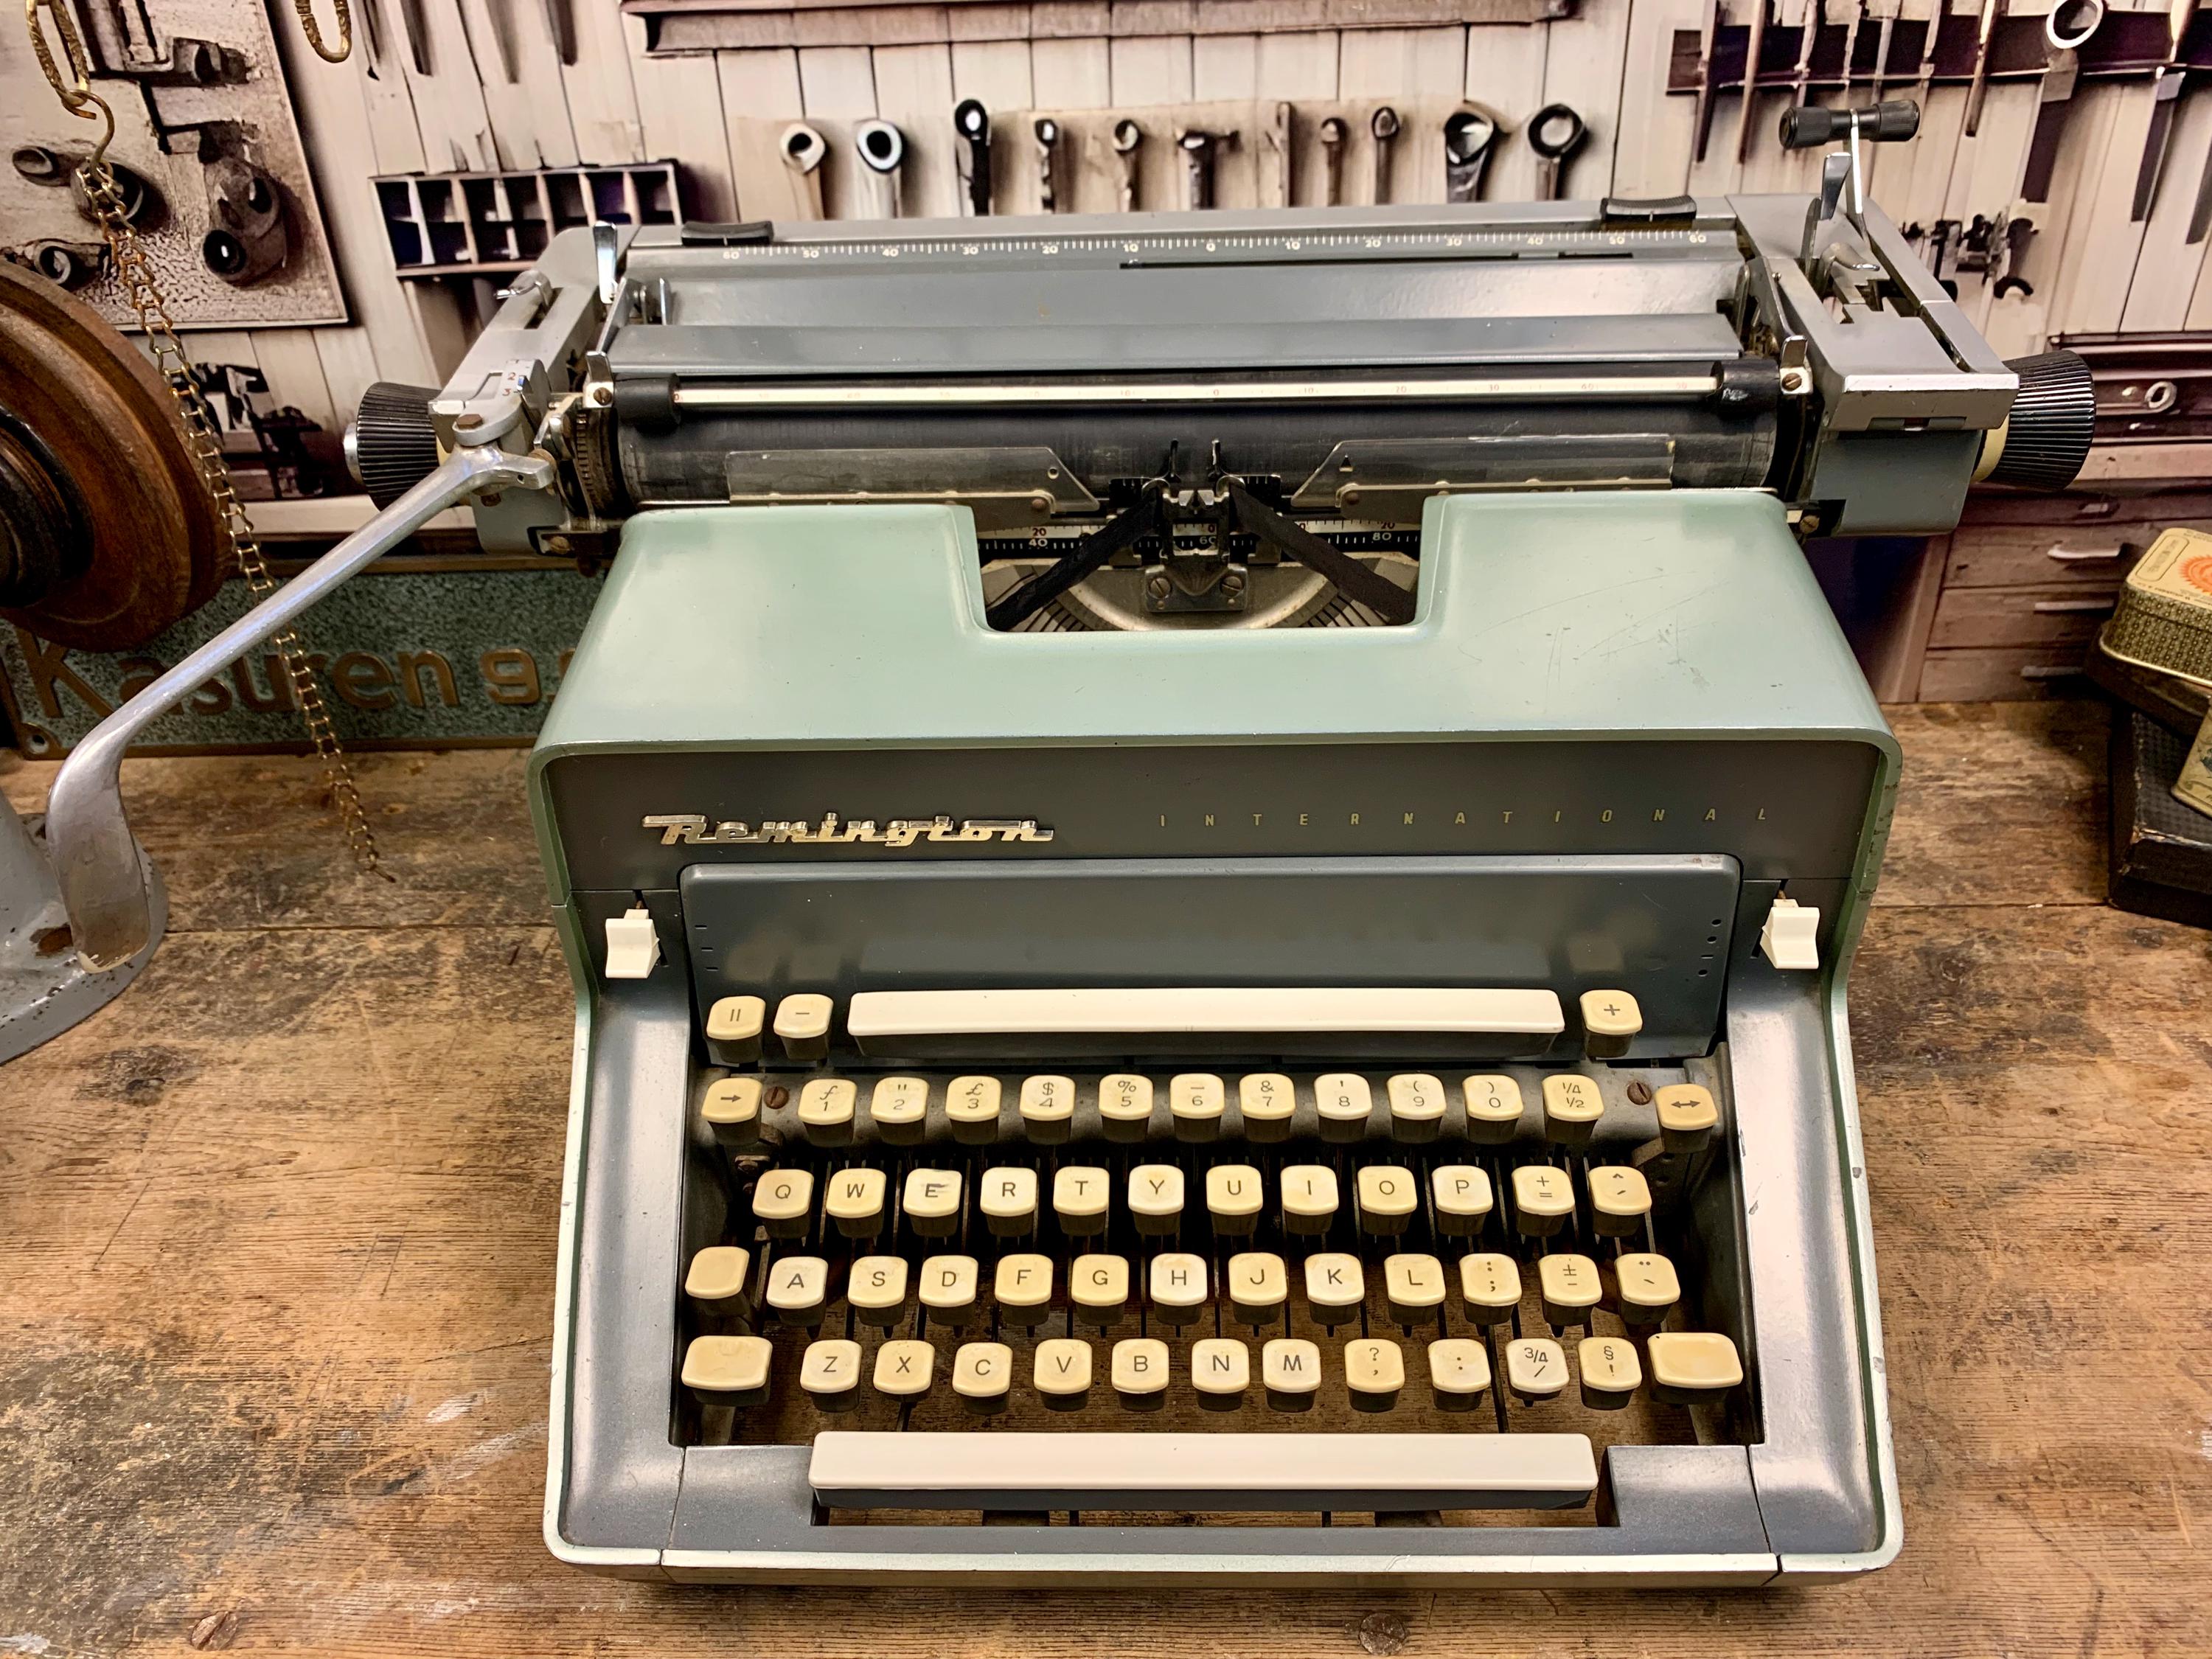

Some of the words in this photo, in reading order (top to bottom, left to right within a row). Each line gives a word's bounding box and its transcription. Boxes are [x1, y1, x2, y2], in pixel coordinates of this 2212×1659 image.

[802, 249, 820, 259] 50
[882, 248, 900, 257] 40
[961, 246, 979, 255] 30
[1042, 245, 1059, 254] 20
[1122, 243, 1139, 253] 10
[1206, 243, 1216, 252] 0
[1284, 240, 1301, 251] 10
[1364, 238, 1382, 248] 20
[1446, 237, 1463, 247] 30
[1526, 235, 1544, 246] 40
[1609, 235, 1626, 246] 50
[1688, 234, 1707, 244] 60
[507, 372, 516, 380] 2
[501, 388, 512, 397] 3
[1032, 527, 1047, 537] 20
[1208, 524, 1216, 534] 0
[1028, 538, 1048, 547] 40
[1371, 532, 1393, 541] 80
[641, 813, 1054, 847] Remington
[965, 1082, 984, 1096] £
[1042, 1082, 1054, 1096] $
[1117, 1080, 1137, 1093] %
[1260, 1080, 1275, 1093] &
[893, 1099, 905, 1110] 2
[967, 1098, 979, 1110] 3
[1039, 1098, 1053, 1108] 4
[1120, 1096, 1132, 1107] 5
[1192, 1096, 1203, 1106] 6
[1262, 1096, 1273, 1107] 7
[1338, 1096, 1351, 1107] 8
[1413, 1096, 1425, 1107] 9
[1489, 1097, 1501, 1108] 0
[774, 1184, 791, 1200] Q
[846, 1183, 865, 1198] W
[925, 1183, 939, 1198] E
[1001, 1182, 1016, 1197] R
[1074, 1180, 1089, 1196] T
[1149, 1179, 1165, 1195] Y
[1227, 1180, 1242, 1196] U
[1379, 1180, 1395, 1195] O
[1455, 1179, 1470, 1194] P
[787, 1273, 804, 1289] A
[872, 1270, 886, 1287] S
[942, 1270, 957, 1287] D
[1017, 1269, 1032, 1285] F
[1092, 1270, 1108, 1286] G
[1171, 1270, 1187, 1286] H
[1250, 1268, 1265, 1285] J
[1327, 1268, 1343, 1284] K
[1407, 1269, 1424, 1286] L
[1369, 1347, 1380, 1362] ?
[822, 1356, 838, 1373] Z
[896, 1356, 911, 1374] X
[975, 1359, 991, 1376] C
[1056, 1356, 1072, 1374] V
[1133, 1355, 1149, 1372] B
[1212, 1354, 1230, 1372] N
[1283, 1354, 1302, 1371] M
[1534, 1365, 1546, 1378] /
